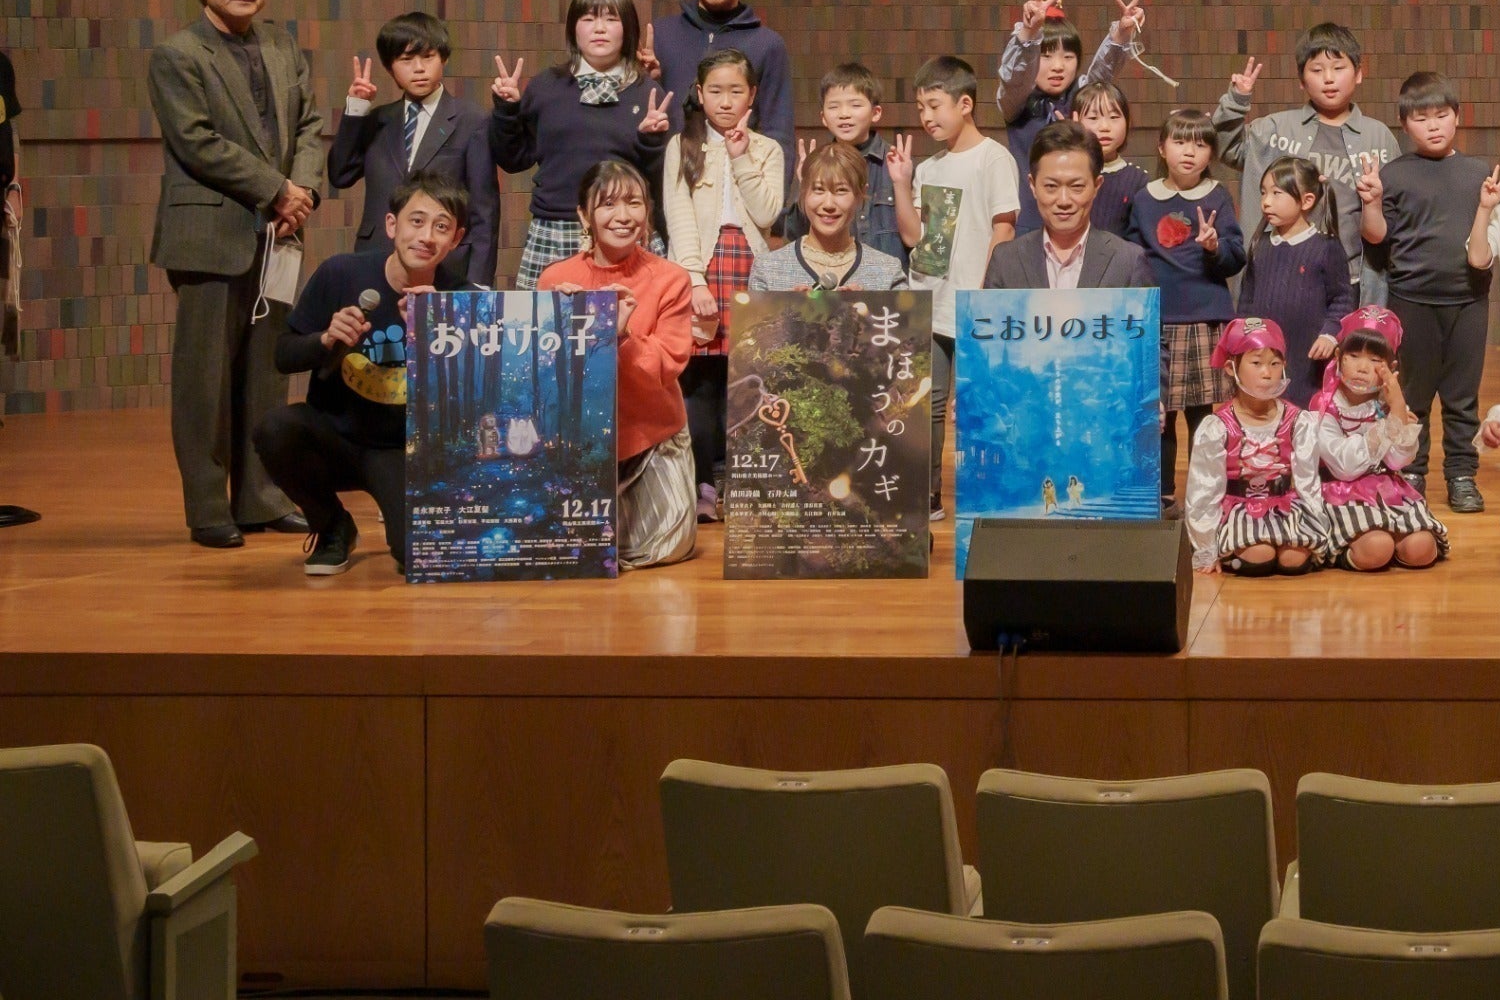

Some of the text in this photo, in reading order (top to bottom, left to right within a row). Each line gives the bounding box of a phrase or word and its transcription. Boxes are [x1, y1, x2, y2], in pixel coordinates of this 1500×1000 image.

[429, 314, 596, 358] おばけの子
[970, 313, 1146, 341] こおりのまち
[857, 305, 914, 501] まほうのカギ
[731, 453, 780, 471] 12.17
[561, 498, 612, 518] 12.17
